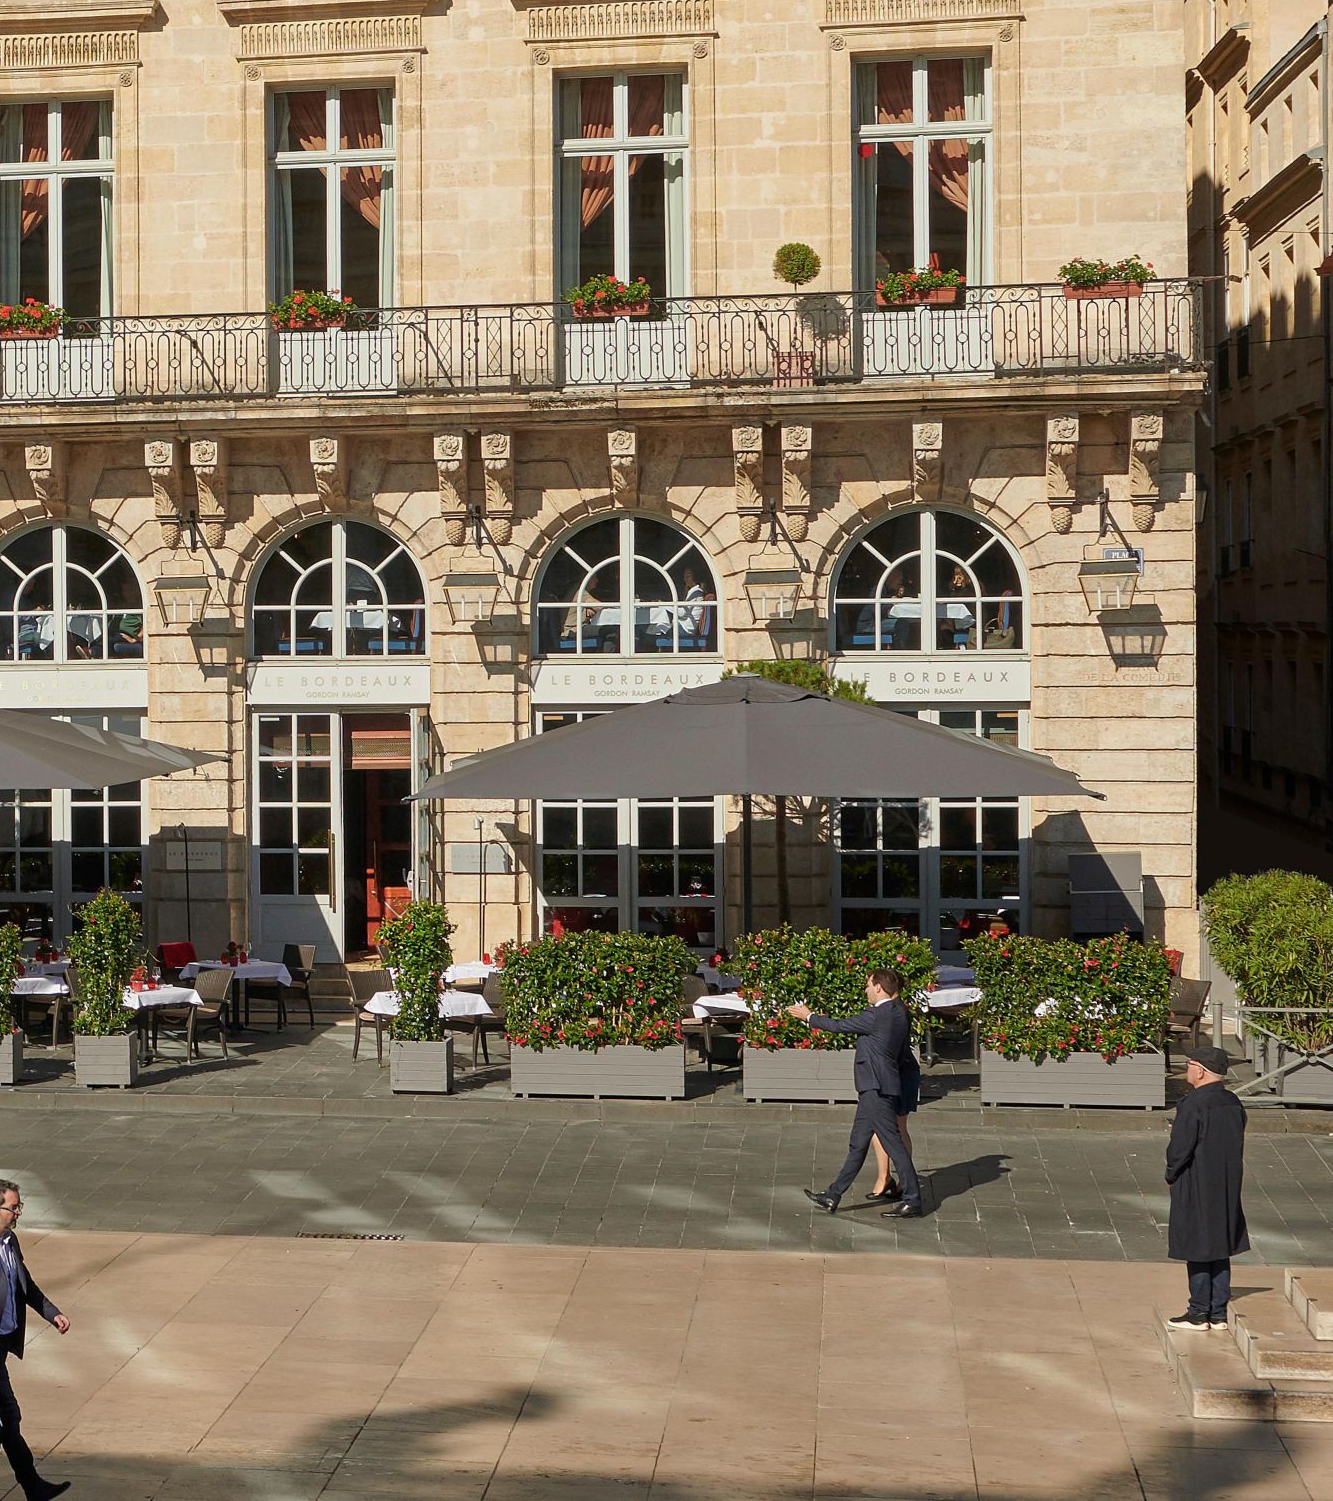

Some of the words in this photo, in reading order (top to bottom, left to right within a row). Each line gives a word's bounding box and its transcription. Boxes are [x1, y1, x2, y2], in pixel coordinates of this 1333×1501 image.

[264, 676, 285, 687] LE
[300, 675, 412, 687] BORDEAUX
[551, 675, 572, 686] LE
[589, 674, 704, 685] BORDEAUX
[889, 672, 1009, 683] BORDEAUX
[305, 691, 339, 699] GORDON
[342, 691, 370, 699] RAMSAY
[594, 690, 628, 698] GORDON
[894, 687, 930, 695] GORDON
[934, 687, 964, 695] RAMSAY
